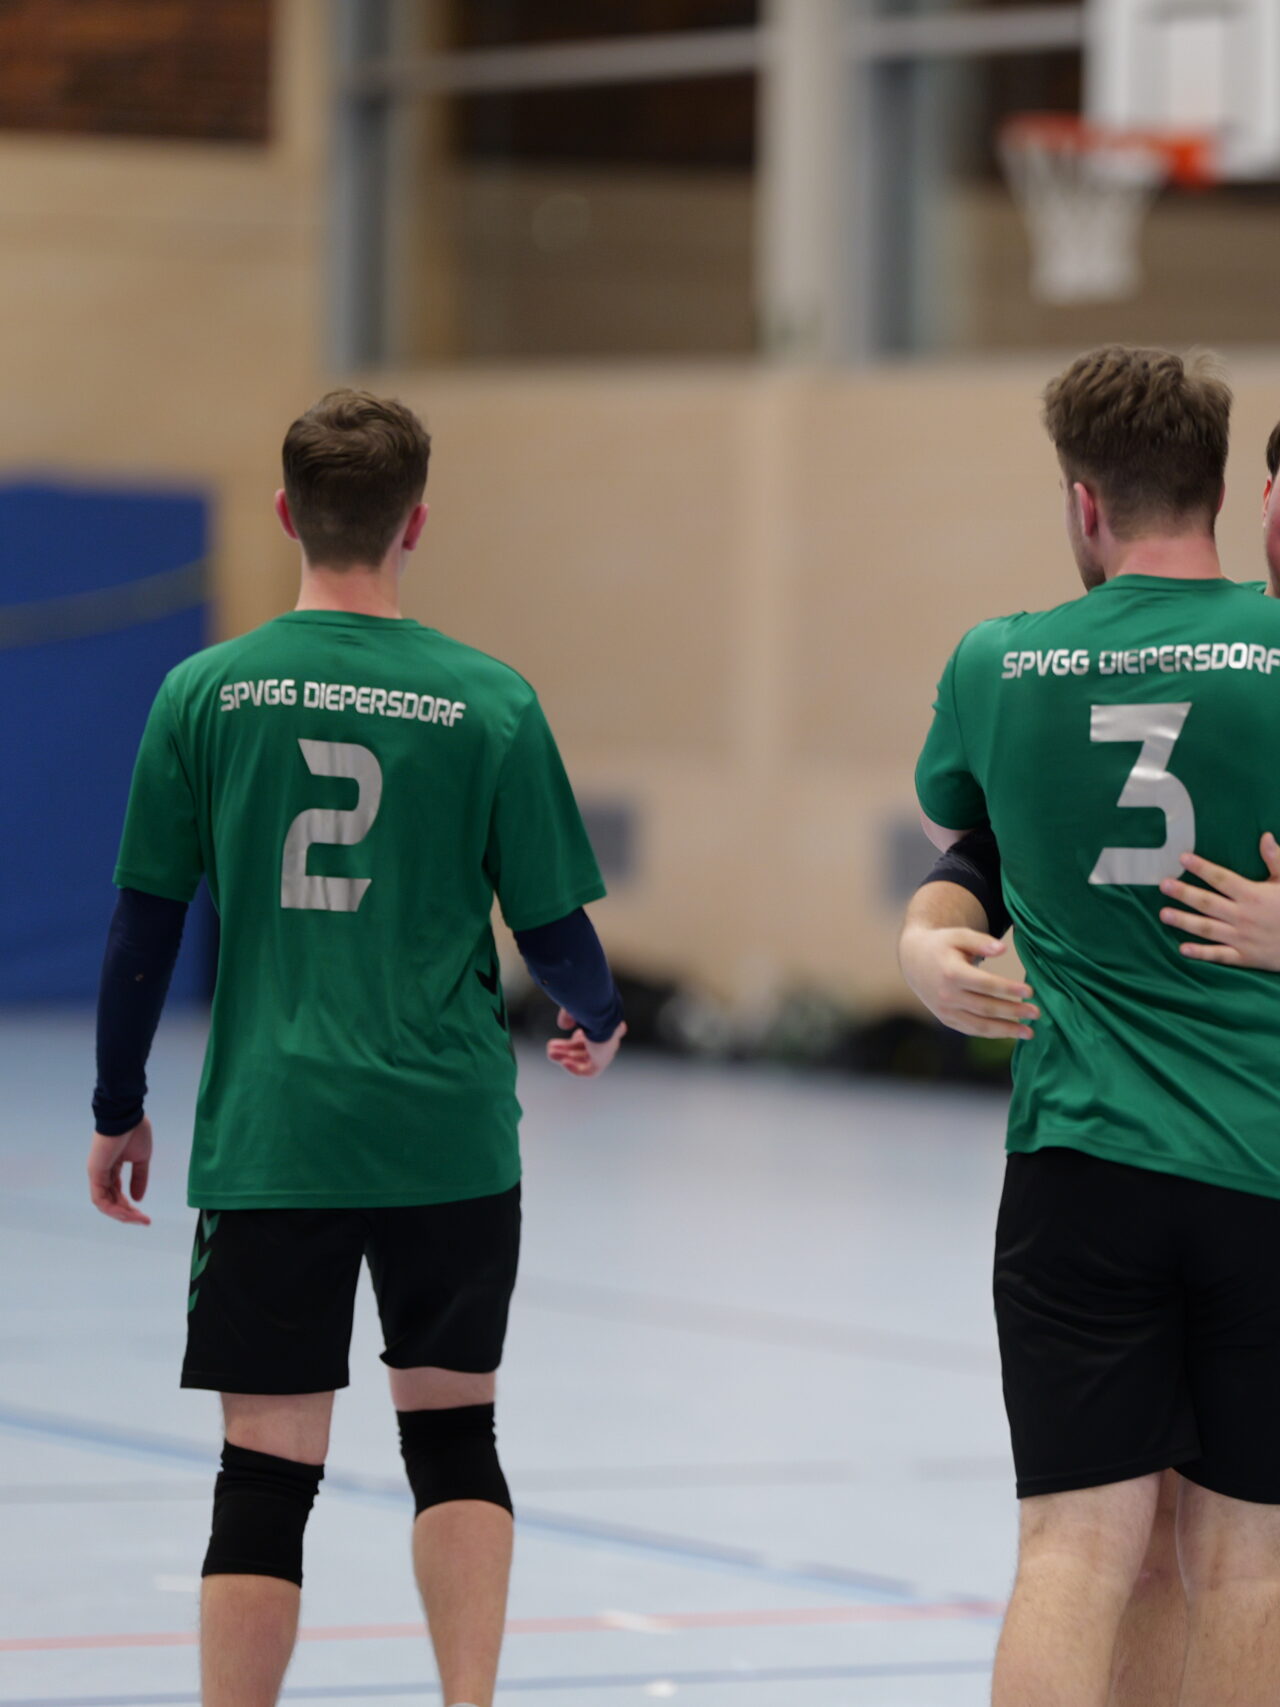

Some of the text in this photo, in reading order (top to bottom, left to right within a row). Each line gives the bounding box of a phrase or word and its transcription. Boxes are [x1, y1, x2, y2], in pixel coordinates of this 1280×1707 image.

[219, 679, 466, 727] SPVGG DIEPERSDORF
[1001, 649, 1090, 679] SPVGG
[280, 738, 383, 912] 2
[1088, 702, 1196, 886] 3
